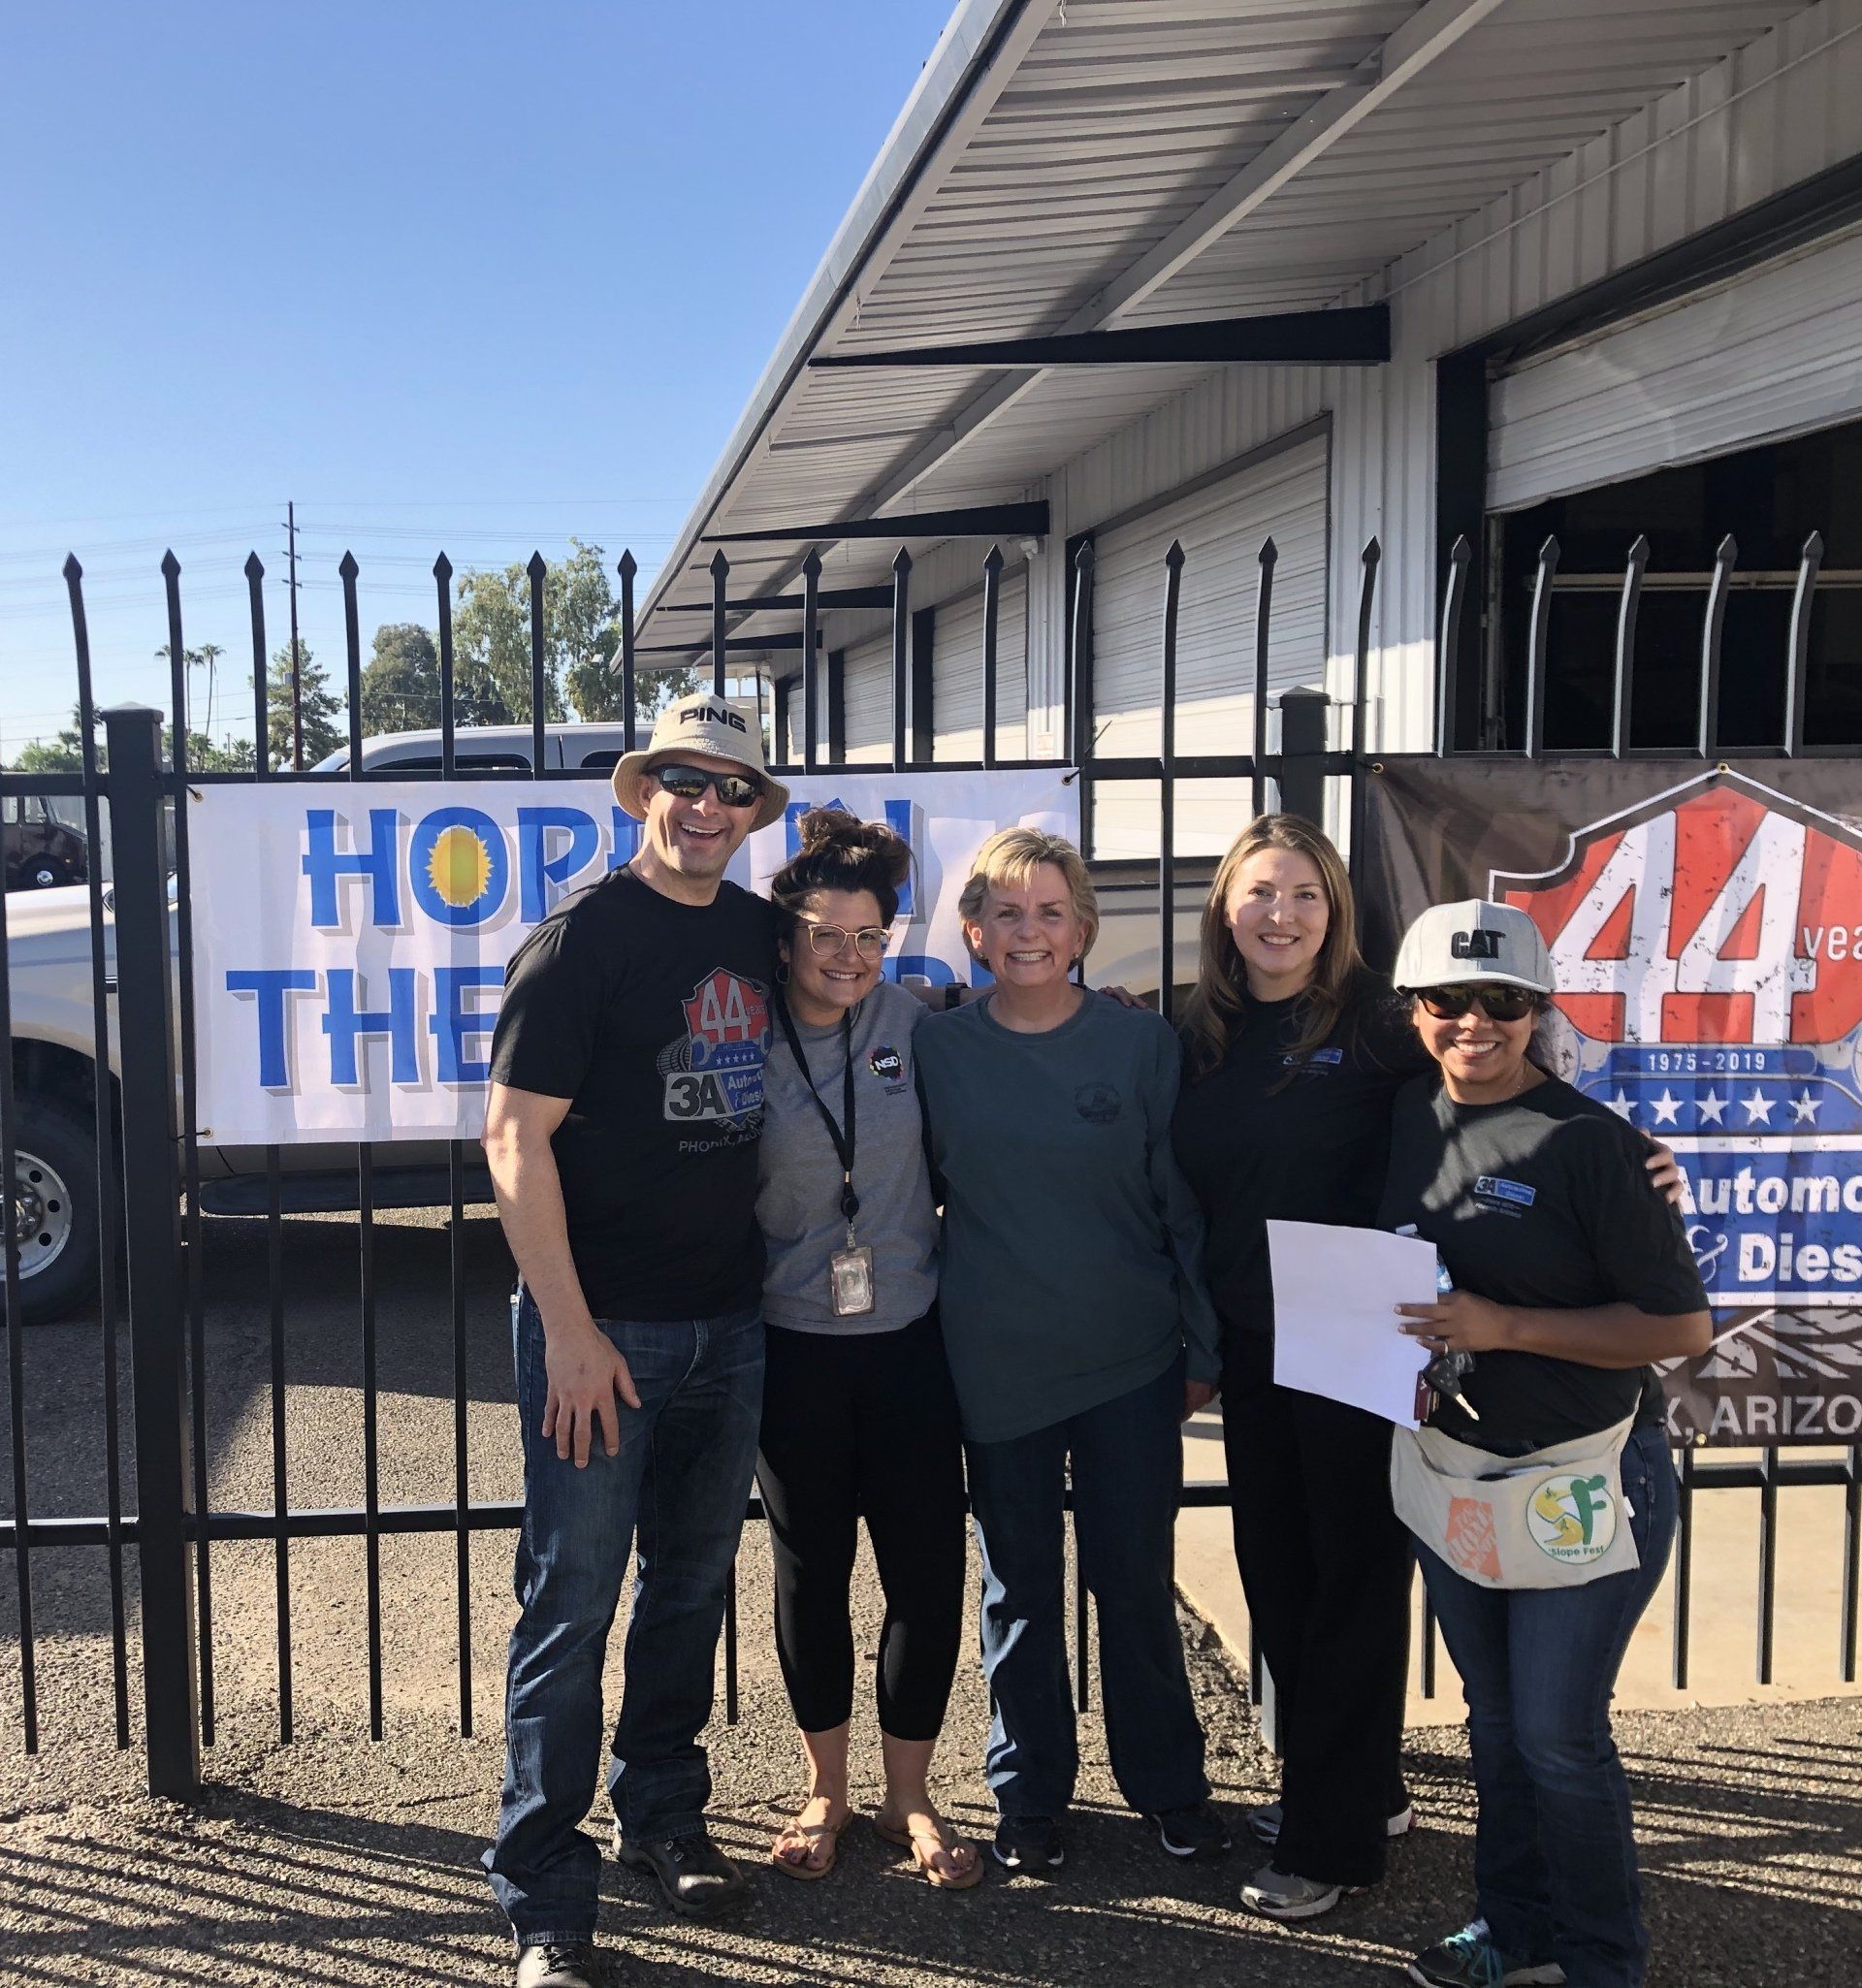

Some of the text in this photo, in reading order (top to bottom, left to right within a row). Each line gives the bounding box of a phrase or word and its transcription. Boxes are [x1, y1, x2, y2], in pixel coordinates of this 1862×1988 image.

[680, 707, 747, 734] PING
[1451, 929, 1506, 959] CAT
[1549, 810, 1816, 1044] 44
[700, 977, 752, 1043] 44
[875, 1055, 899, 1071] NSD
[1648, 1051, 1766, 1072] 1975-2019
[668, 1073, 727, 1118] 3A
[1709, 1395, 1862, 1436] ARIZO
